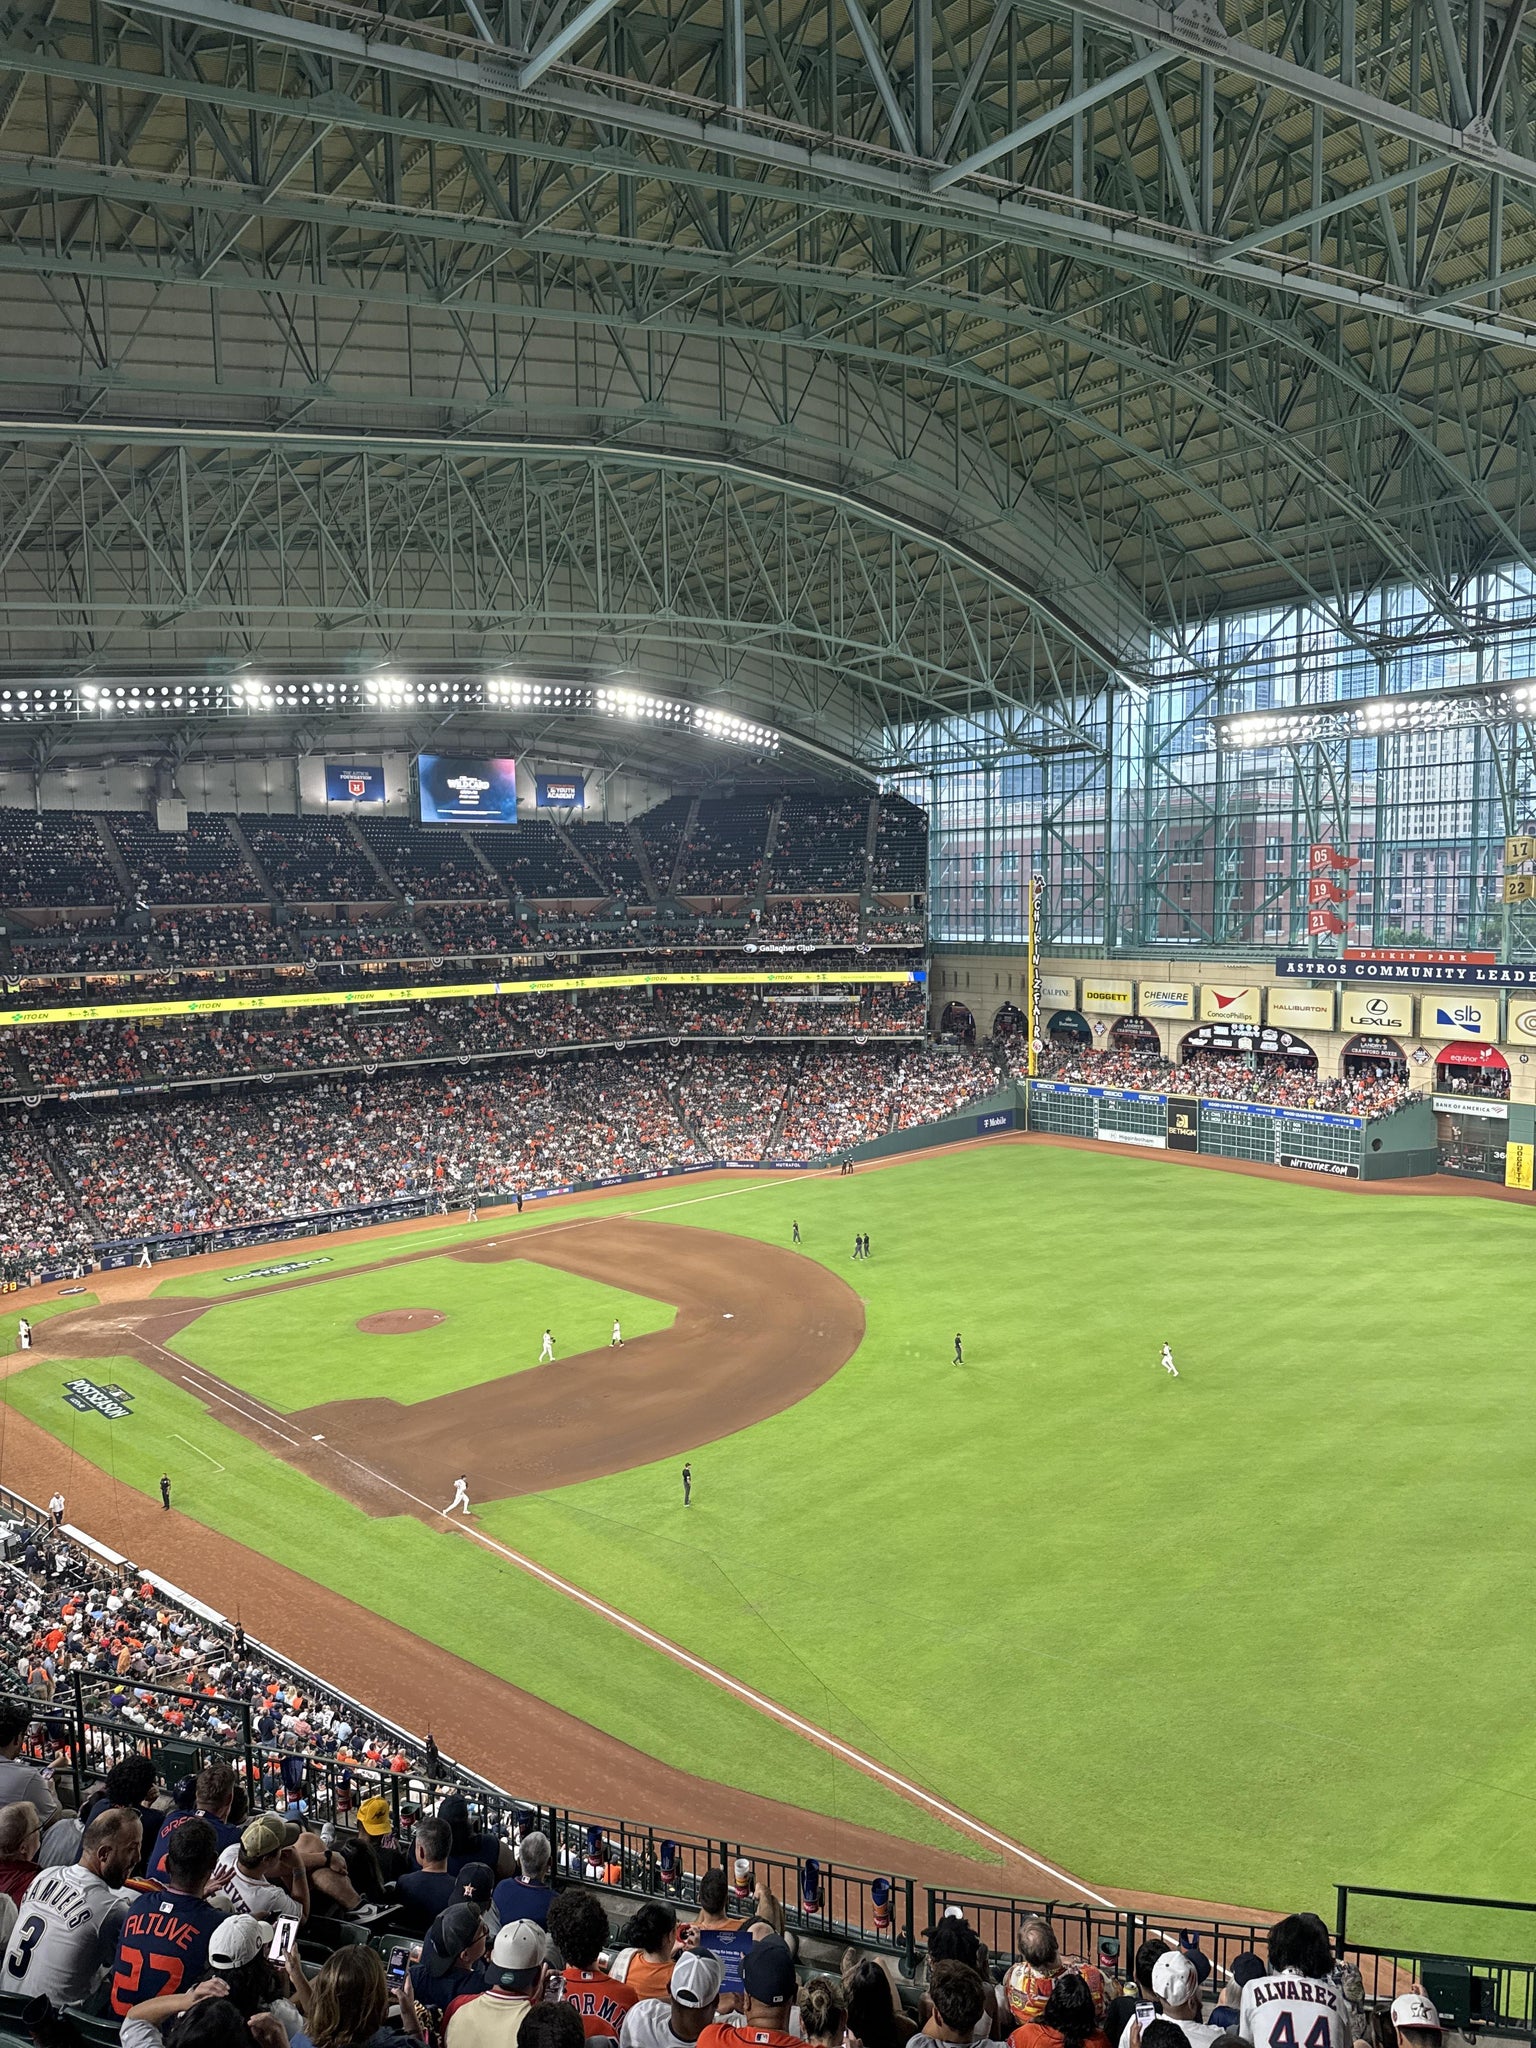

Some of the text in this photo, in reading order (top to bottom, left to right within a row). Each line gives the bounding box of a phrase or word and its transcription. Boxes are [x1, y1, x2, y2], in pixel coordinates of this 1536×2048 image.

[1314, 849, 1327, 863] 05
[1512, 843, 1528, 857] 17
[1314, 884, 1327, 896] 19
[1509, 882, 1525, 895] 22
[1312, 915, 1324, 927] 21
[1032, 900, 1041, 965] CHIKIN
[760, 944, 816, 954] Gallagher Club
[1360, 952, 1468, 962] DAIKIN PARK
[1286, 963, 1347, 974] ASTROS
[1355, 965, 1467, 979] COMMUNITY
[1042, 988, 1069, 997] CALPINE
[1087, 992, 1127, 1001] DOGGETT
[1144, 990, 1188, 1001] CHENIERE
[1032, 991, 1041, 1038] FAIR
[1273, 1004, 1328, 1013] HALLIBURTON
[1454, 1005, 1481, 1022] slb
[1207, 1010, 1252, 1021] ConocoPhillips
[1350, 1016, 1402, 1027] LEXUS
[1450, 1054, 1478, 1063] equinor
[1461, 1104, 1490, 1113] AMERICA
[989, 1116, 1007, 1127] Mobile
[1168, 1127, 1197, 1136] BETMGM
[1493, 1151, 1507, 1159] 36
[1290, 1158, 1348, 1175] NITTOTIRE.COM
[601, 1178, 622, 1186] abbvie
[67, 1379, 130, 1418] POSTSEASON
[124, 1912, 200, 1951] ALTUVE
[7, 1913, 48, 1980] 3
[111, 1945, 184, 2017] 27
[1253, 1980, 1337, 2012] ALVAREZ
[1268, 2010, 1333, 2048] 44
